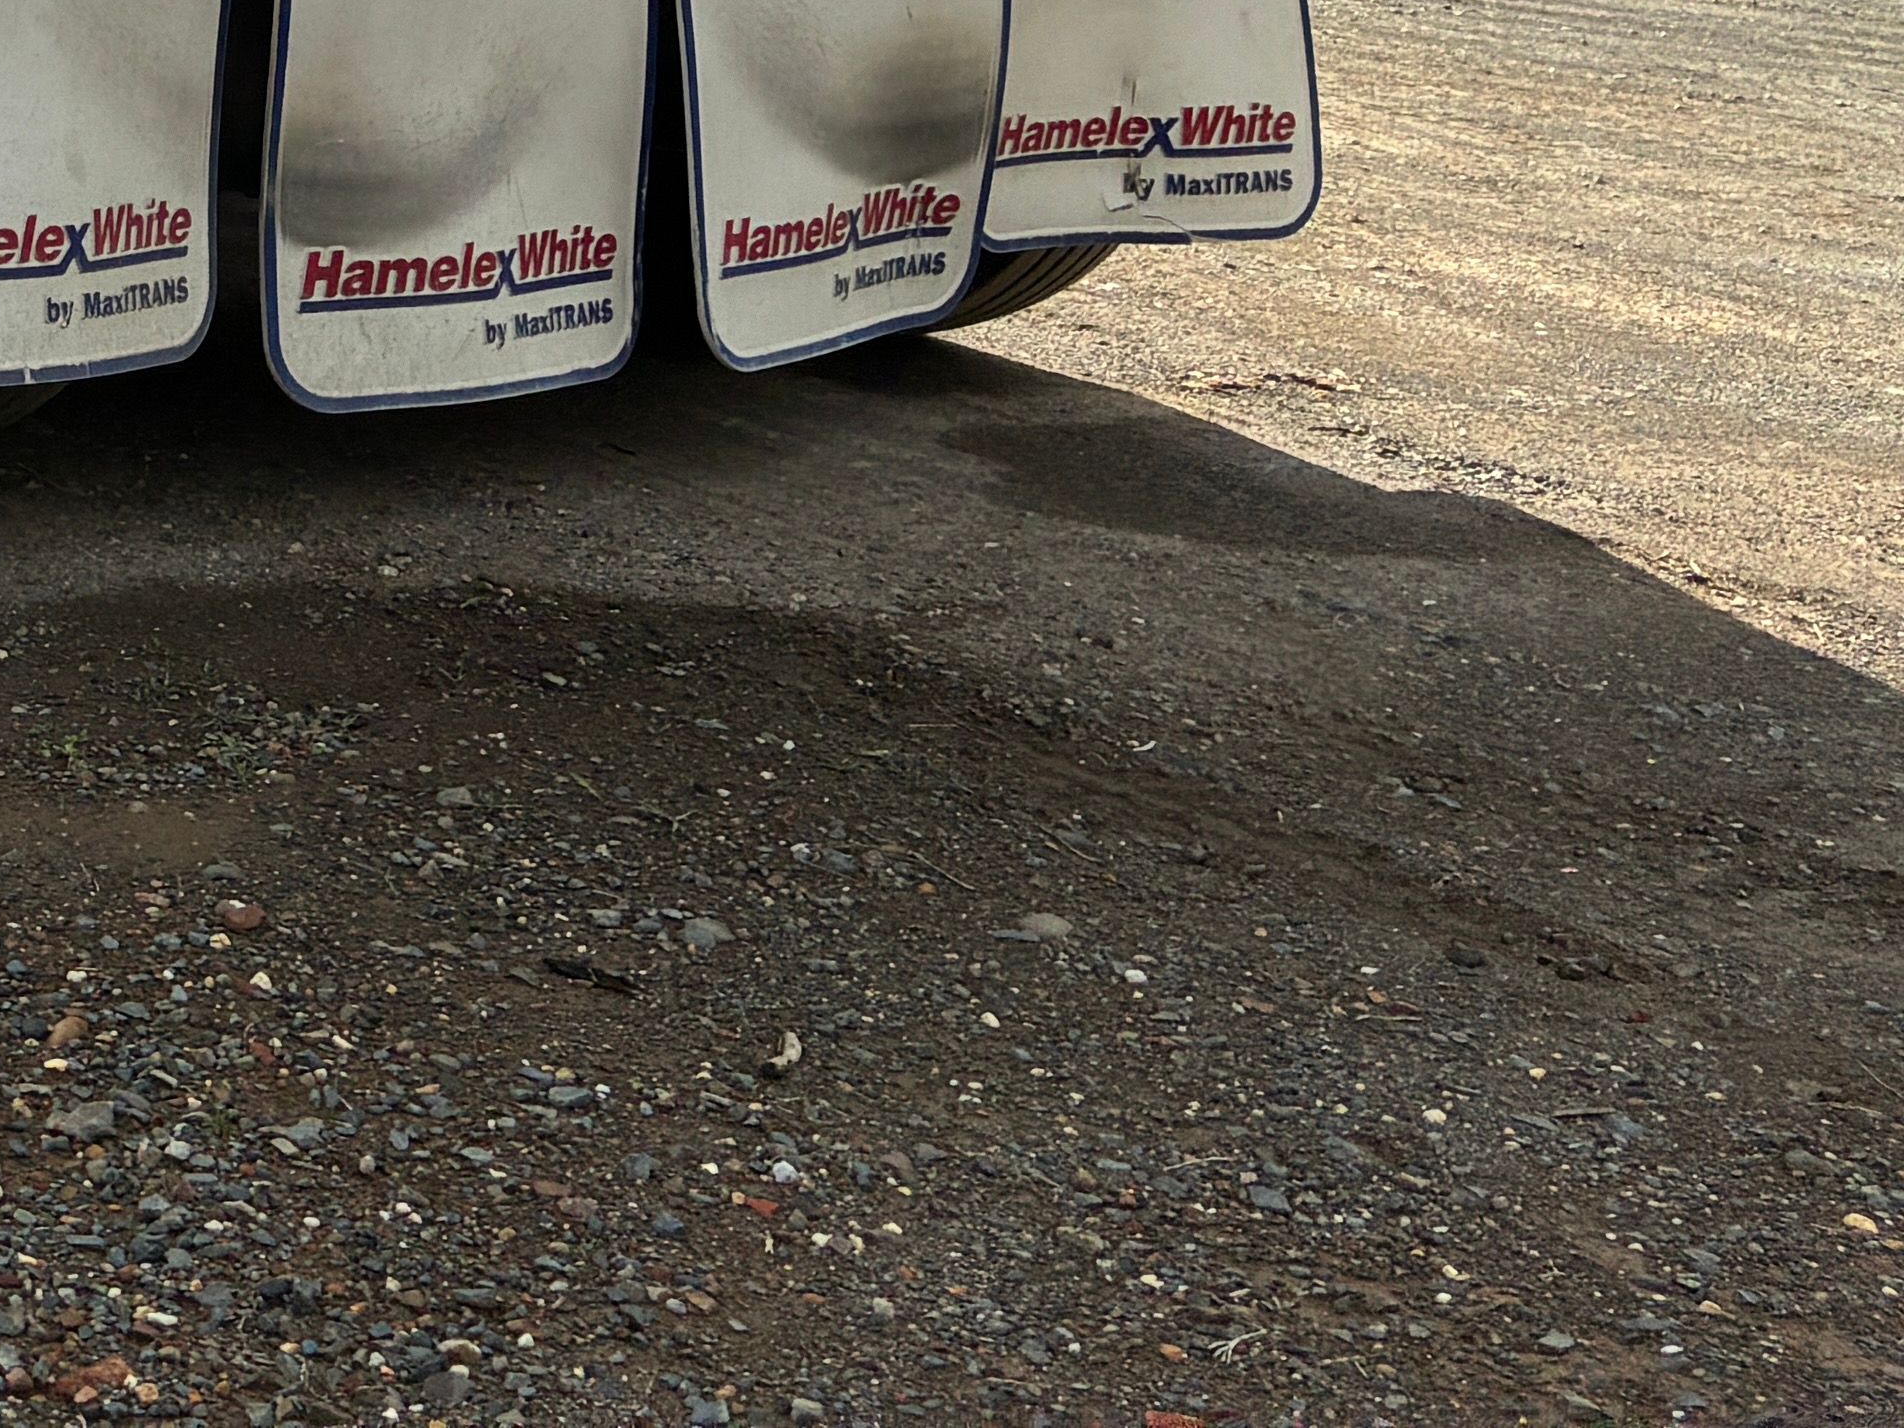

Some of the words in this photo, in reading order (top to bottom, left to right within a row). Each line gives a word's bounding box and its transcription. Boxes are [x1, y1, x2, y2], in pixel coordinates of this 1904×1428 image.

[998, 102, 1296, 157] HamelexWhite
[1165, 168, 1293, 197] MaxiTRANS
[721, 184, 961, 267] HamelexWhite
[301, 224, 618, 301] HamelexWhite
[833, 273, 851, 302] by
[45, 297, 73, 329] by
[83, 276, 189, 321] MaxiTRANS
[483, 318, 507, 350] by
[515, 298, 613, 339] MaxiTRANS
